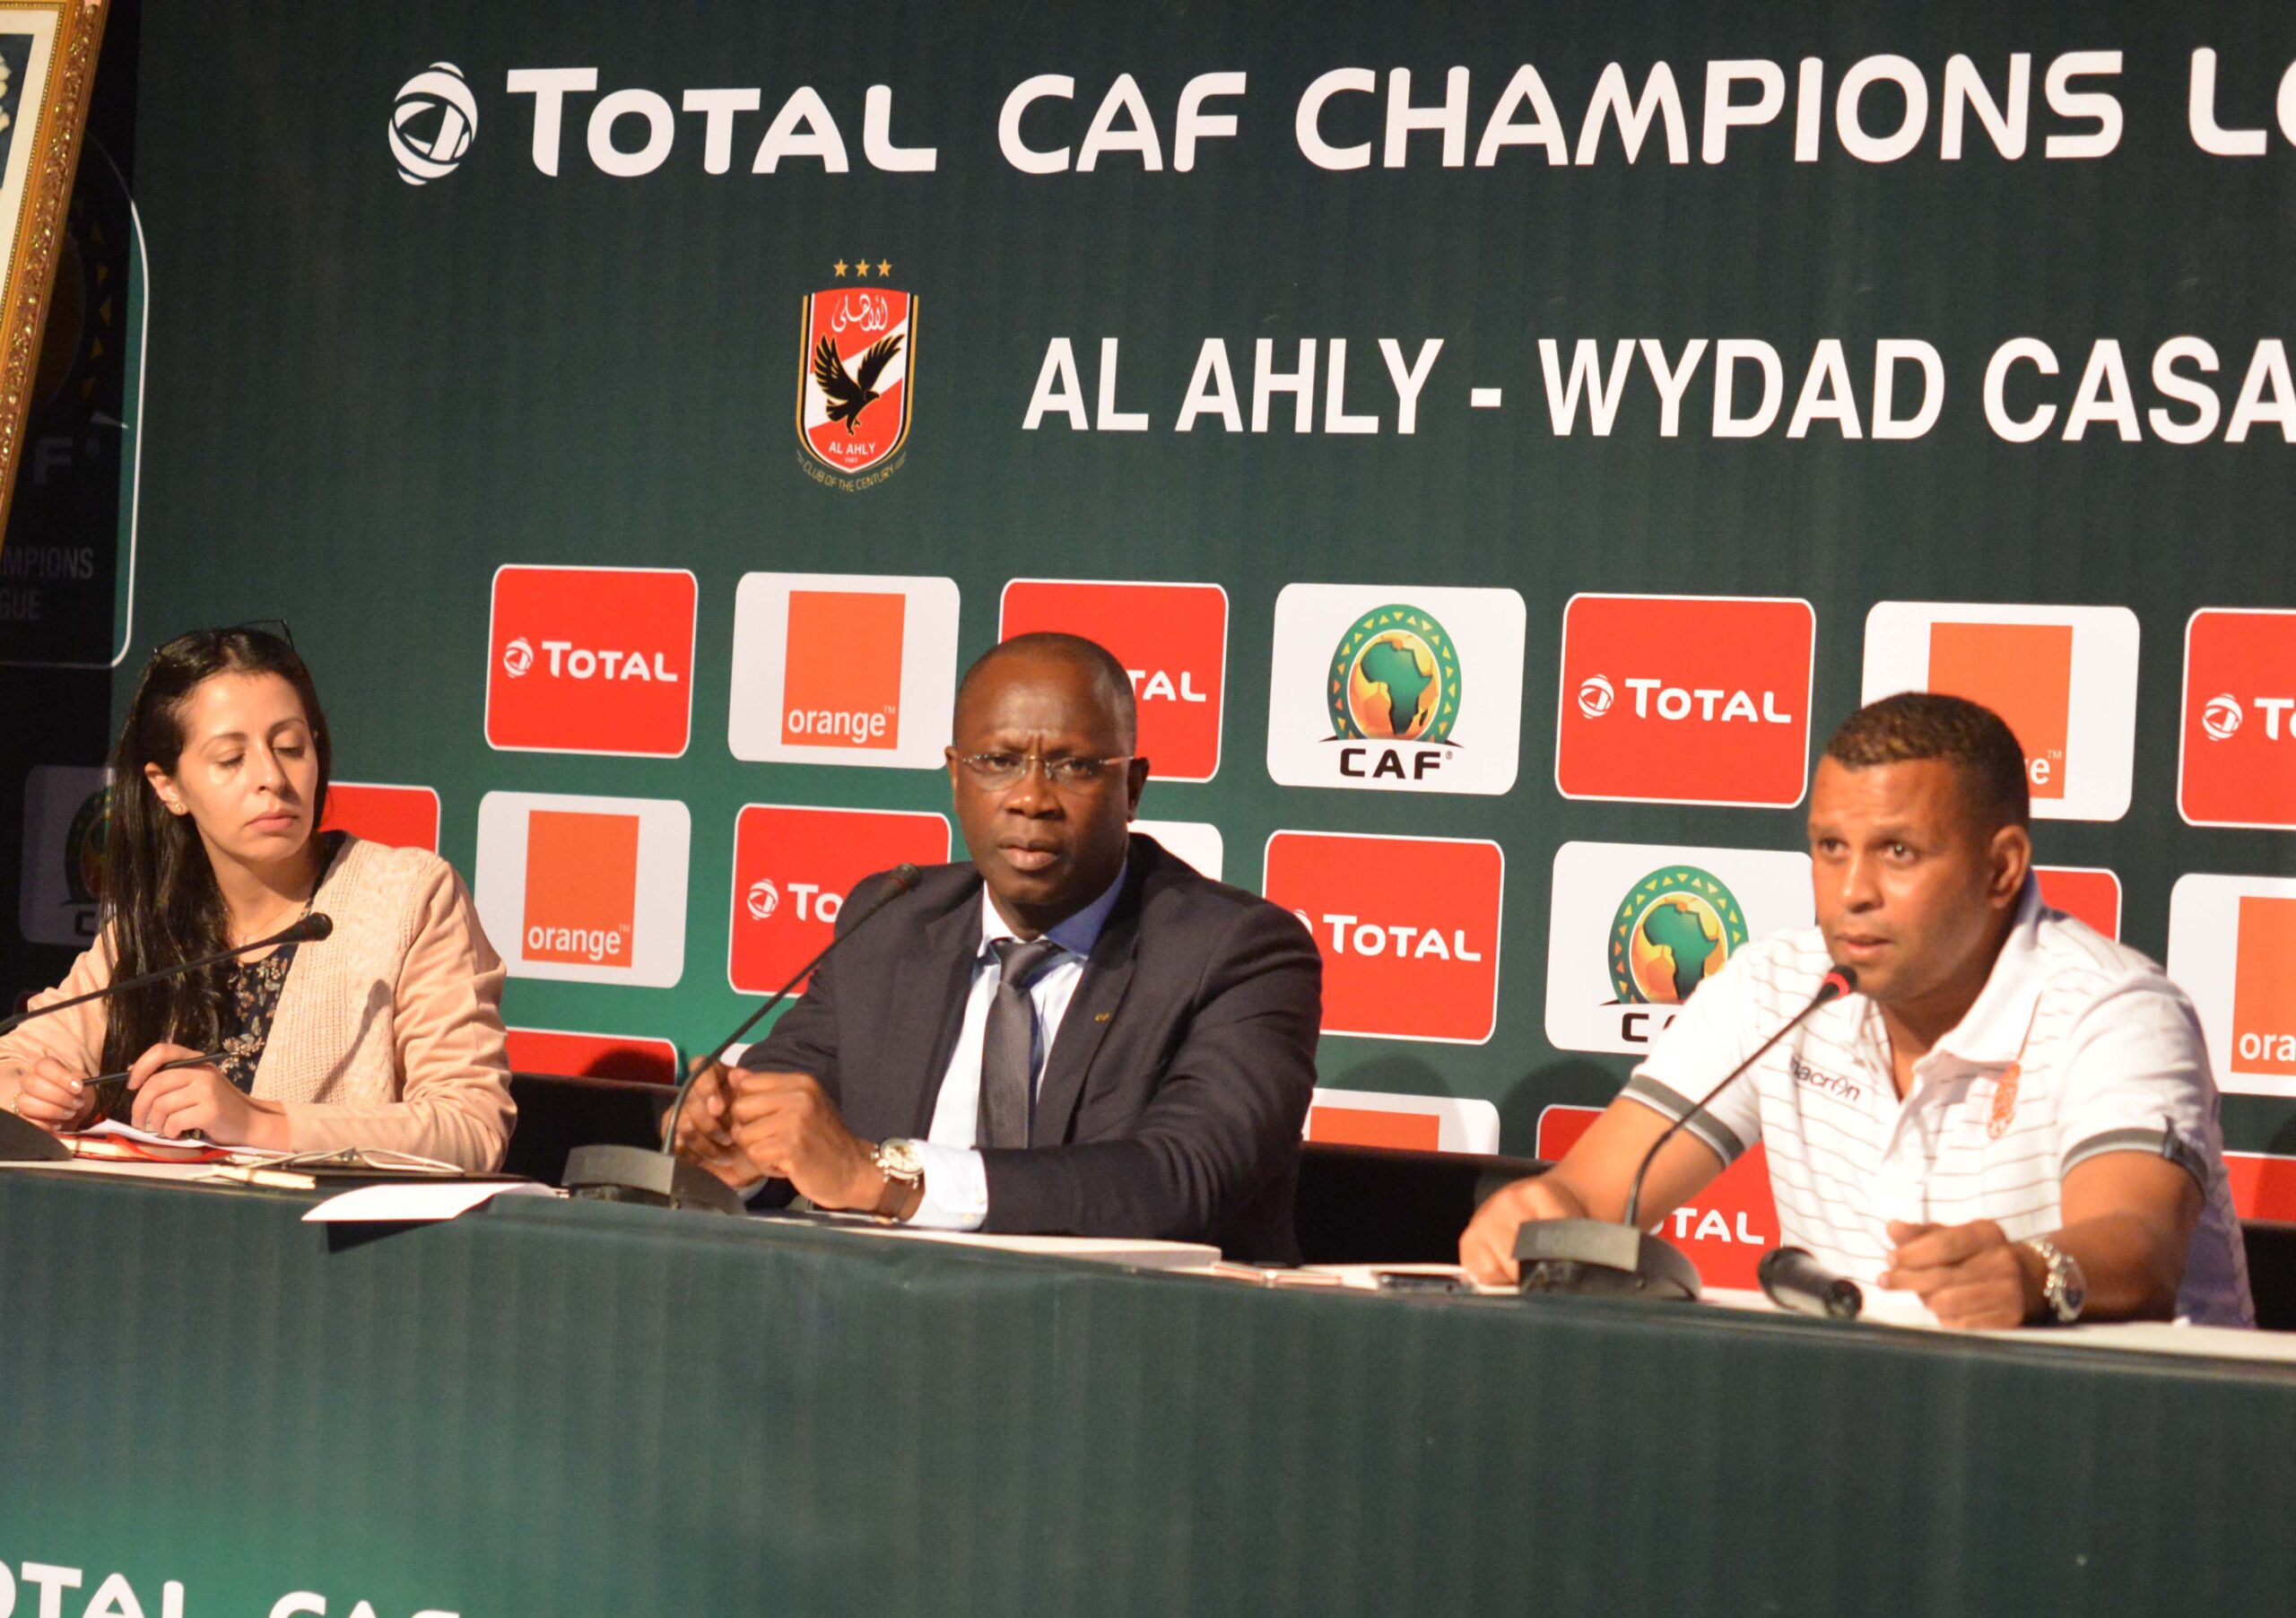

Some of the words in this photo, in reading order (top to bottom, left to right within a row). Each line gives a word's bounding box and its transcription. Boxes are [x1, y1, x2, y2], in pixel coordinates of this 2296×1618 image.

[507, 68, 936, 177] TOTAL
[998, 72, 1246, 173] CAF
[1296, 51, 2123, 170] CHAMPIONS
[1022, 338, 1149, 431] AL
[1175, 338, 1445, 434] AHLY
[1471, 388, 1501, 406] -
[1538, 339, 1944, 439] WYDAD
[1984, 336, 2296, 444] CASA
[829, 441, 842, 454] AL
[846, 442, 875, 456] AHLY
[803, 461, 825, 483] CLUB
[824, 474, 837, 487] OF
[839, 478, 855, 492] THE
[856, 464, 895, 491] CENTURY
[543, 641, 677, 682] TOTAL
[1125, 670, 1205, 701] TAL
[1625, 679, 1792, 723] TOTAL
[787, 709, 886, 744] orange
[1340, 748, 1440, 779] CAF
[527, 926, 621, 961] orange
[1323, 914, 1482, 961] TOTAL
[1666, 1207, 1765, 1245] TAL
